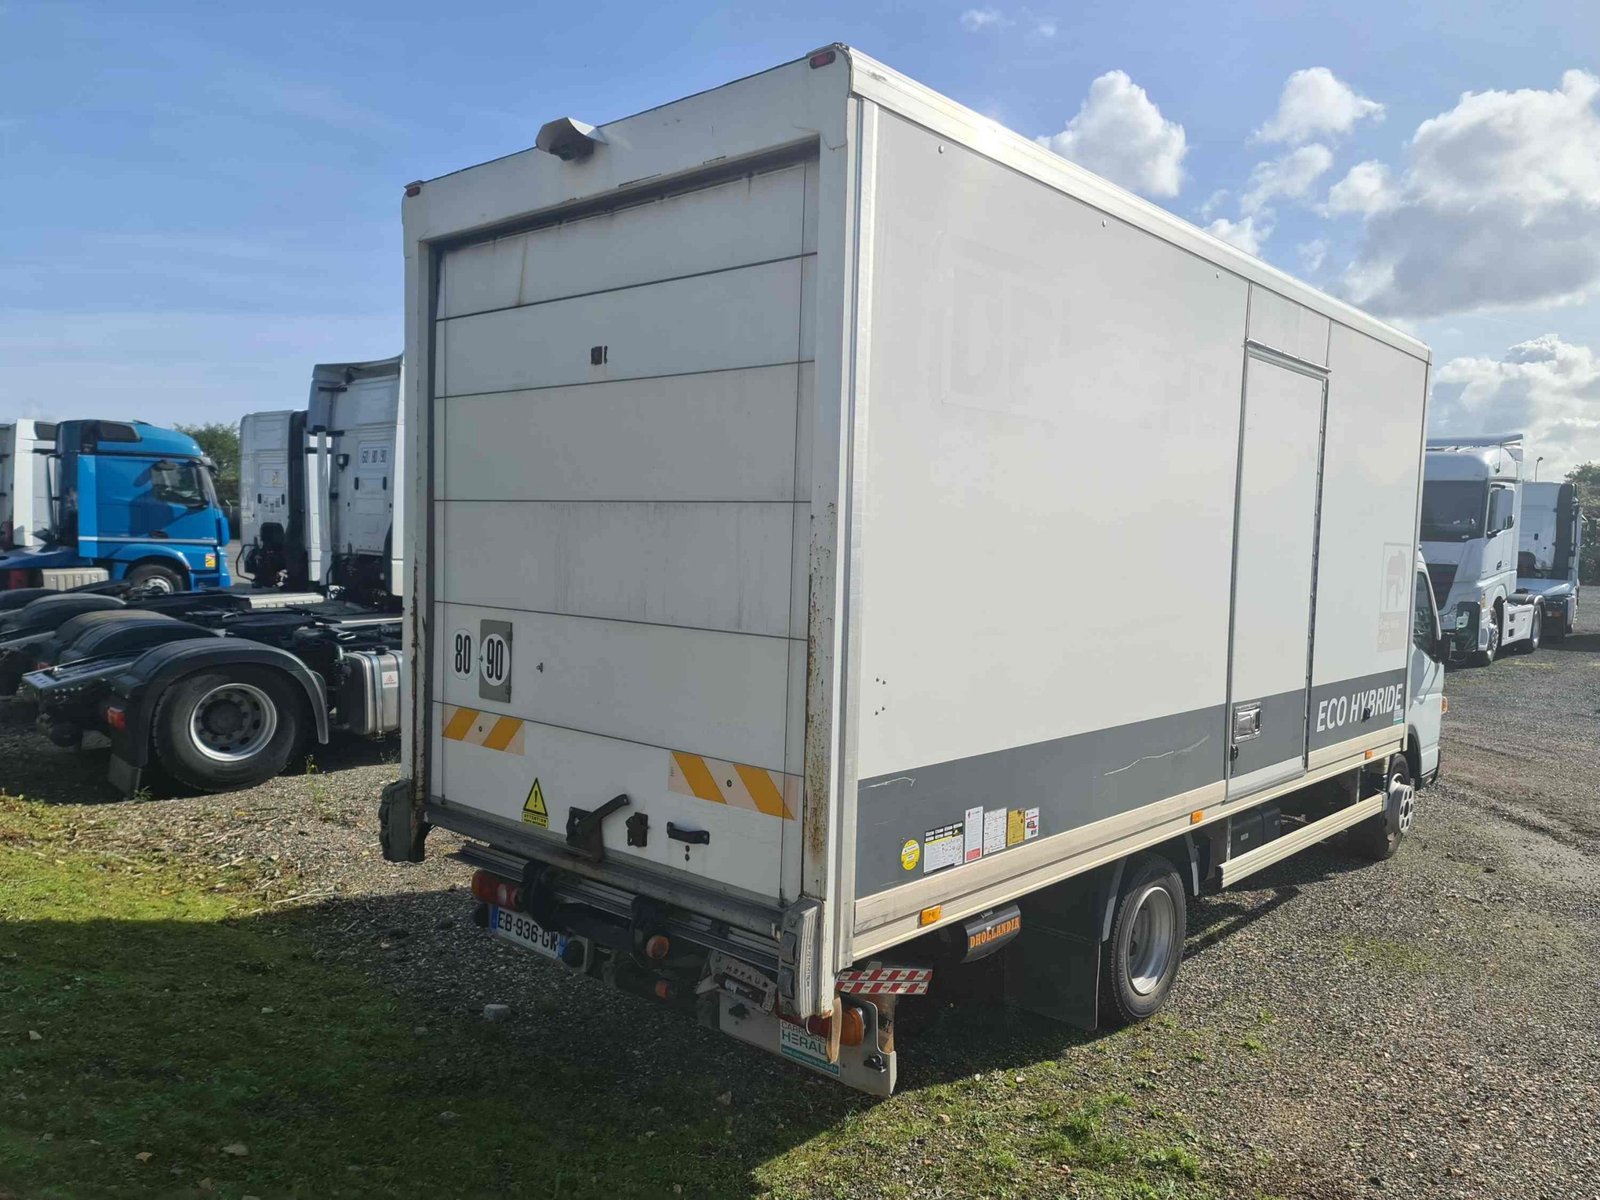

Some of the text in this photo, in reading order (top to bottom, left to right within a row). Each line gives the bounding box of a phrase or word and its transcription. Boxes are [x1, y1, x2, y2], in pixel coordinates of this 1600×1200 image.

[454, 633, 472, 675] 80
[486, 638, 504, 681] 90
[1316, 683, 1404, 733] ECO HYBRIDE
[969, 916, 1020, 948] DHOLLANDIA
[782, 1029, 826, 1055] HERAU
